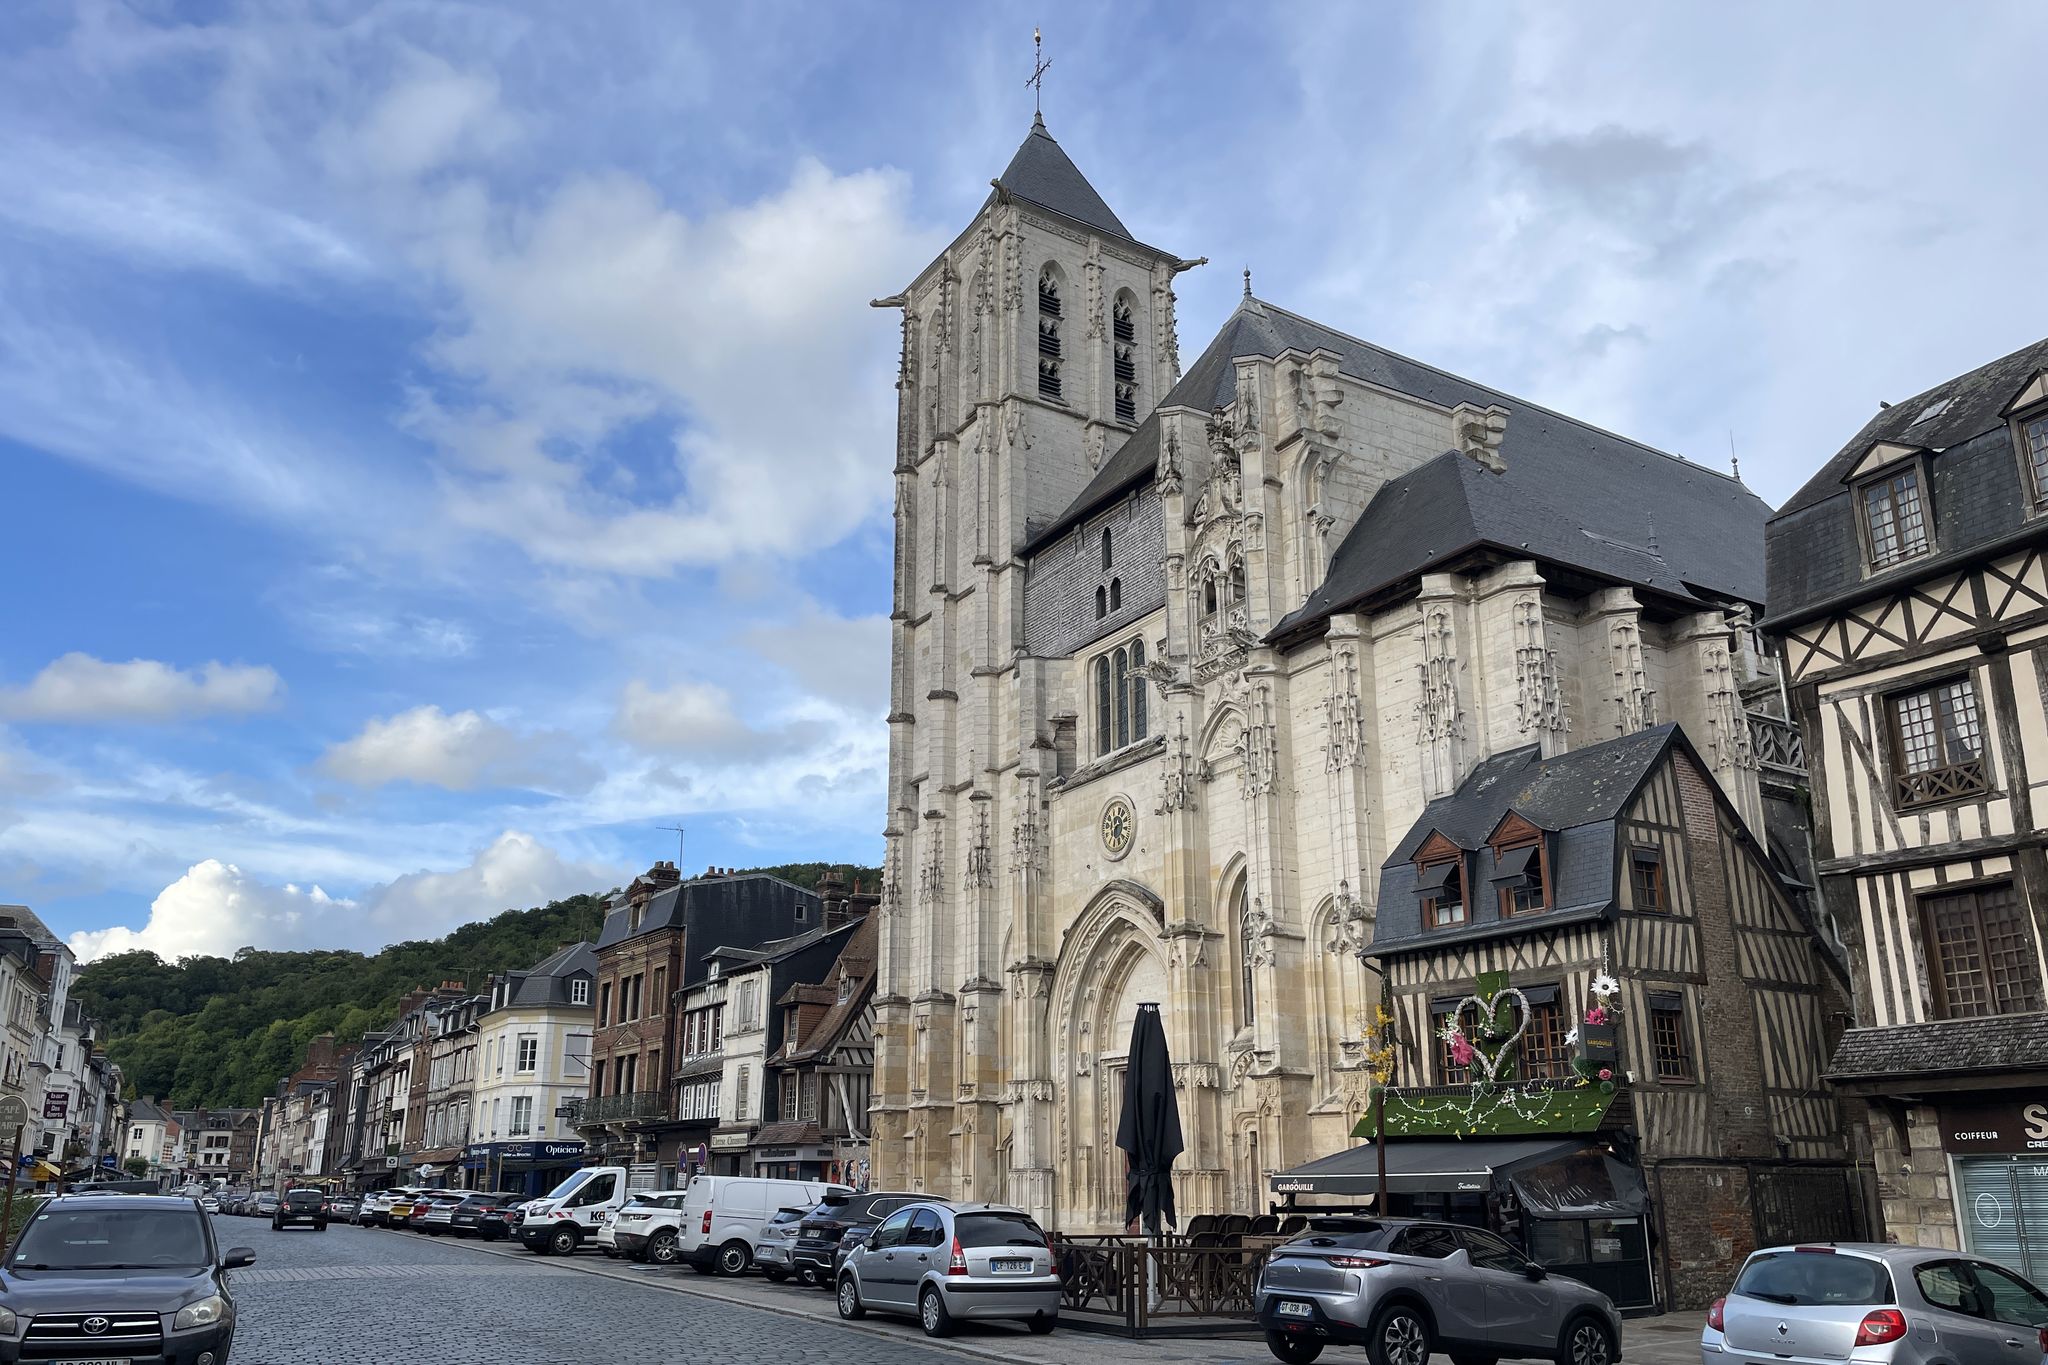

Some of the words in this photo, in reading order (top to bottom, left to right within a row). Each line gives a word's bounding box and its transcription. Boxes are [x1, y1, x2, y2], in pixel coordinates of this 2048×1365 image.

[382, 1100, 392, 1133] PIZZERIA
[1954, 1131, 1999, 1140] COIFFEUR
[545, 1145, 578, 1156] Opticien
